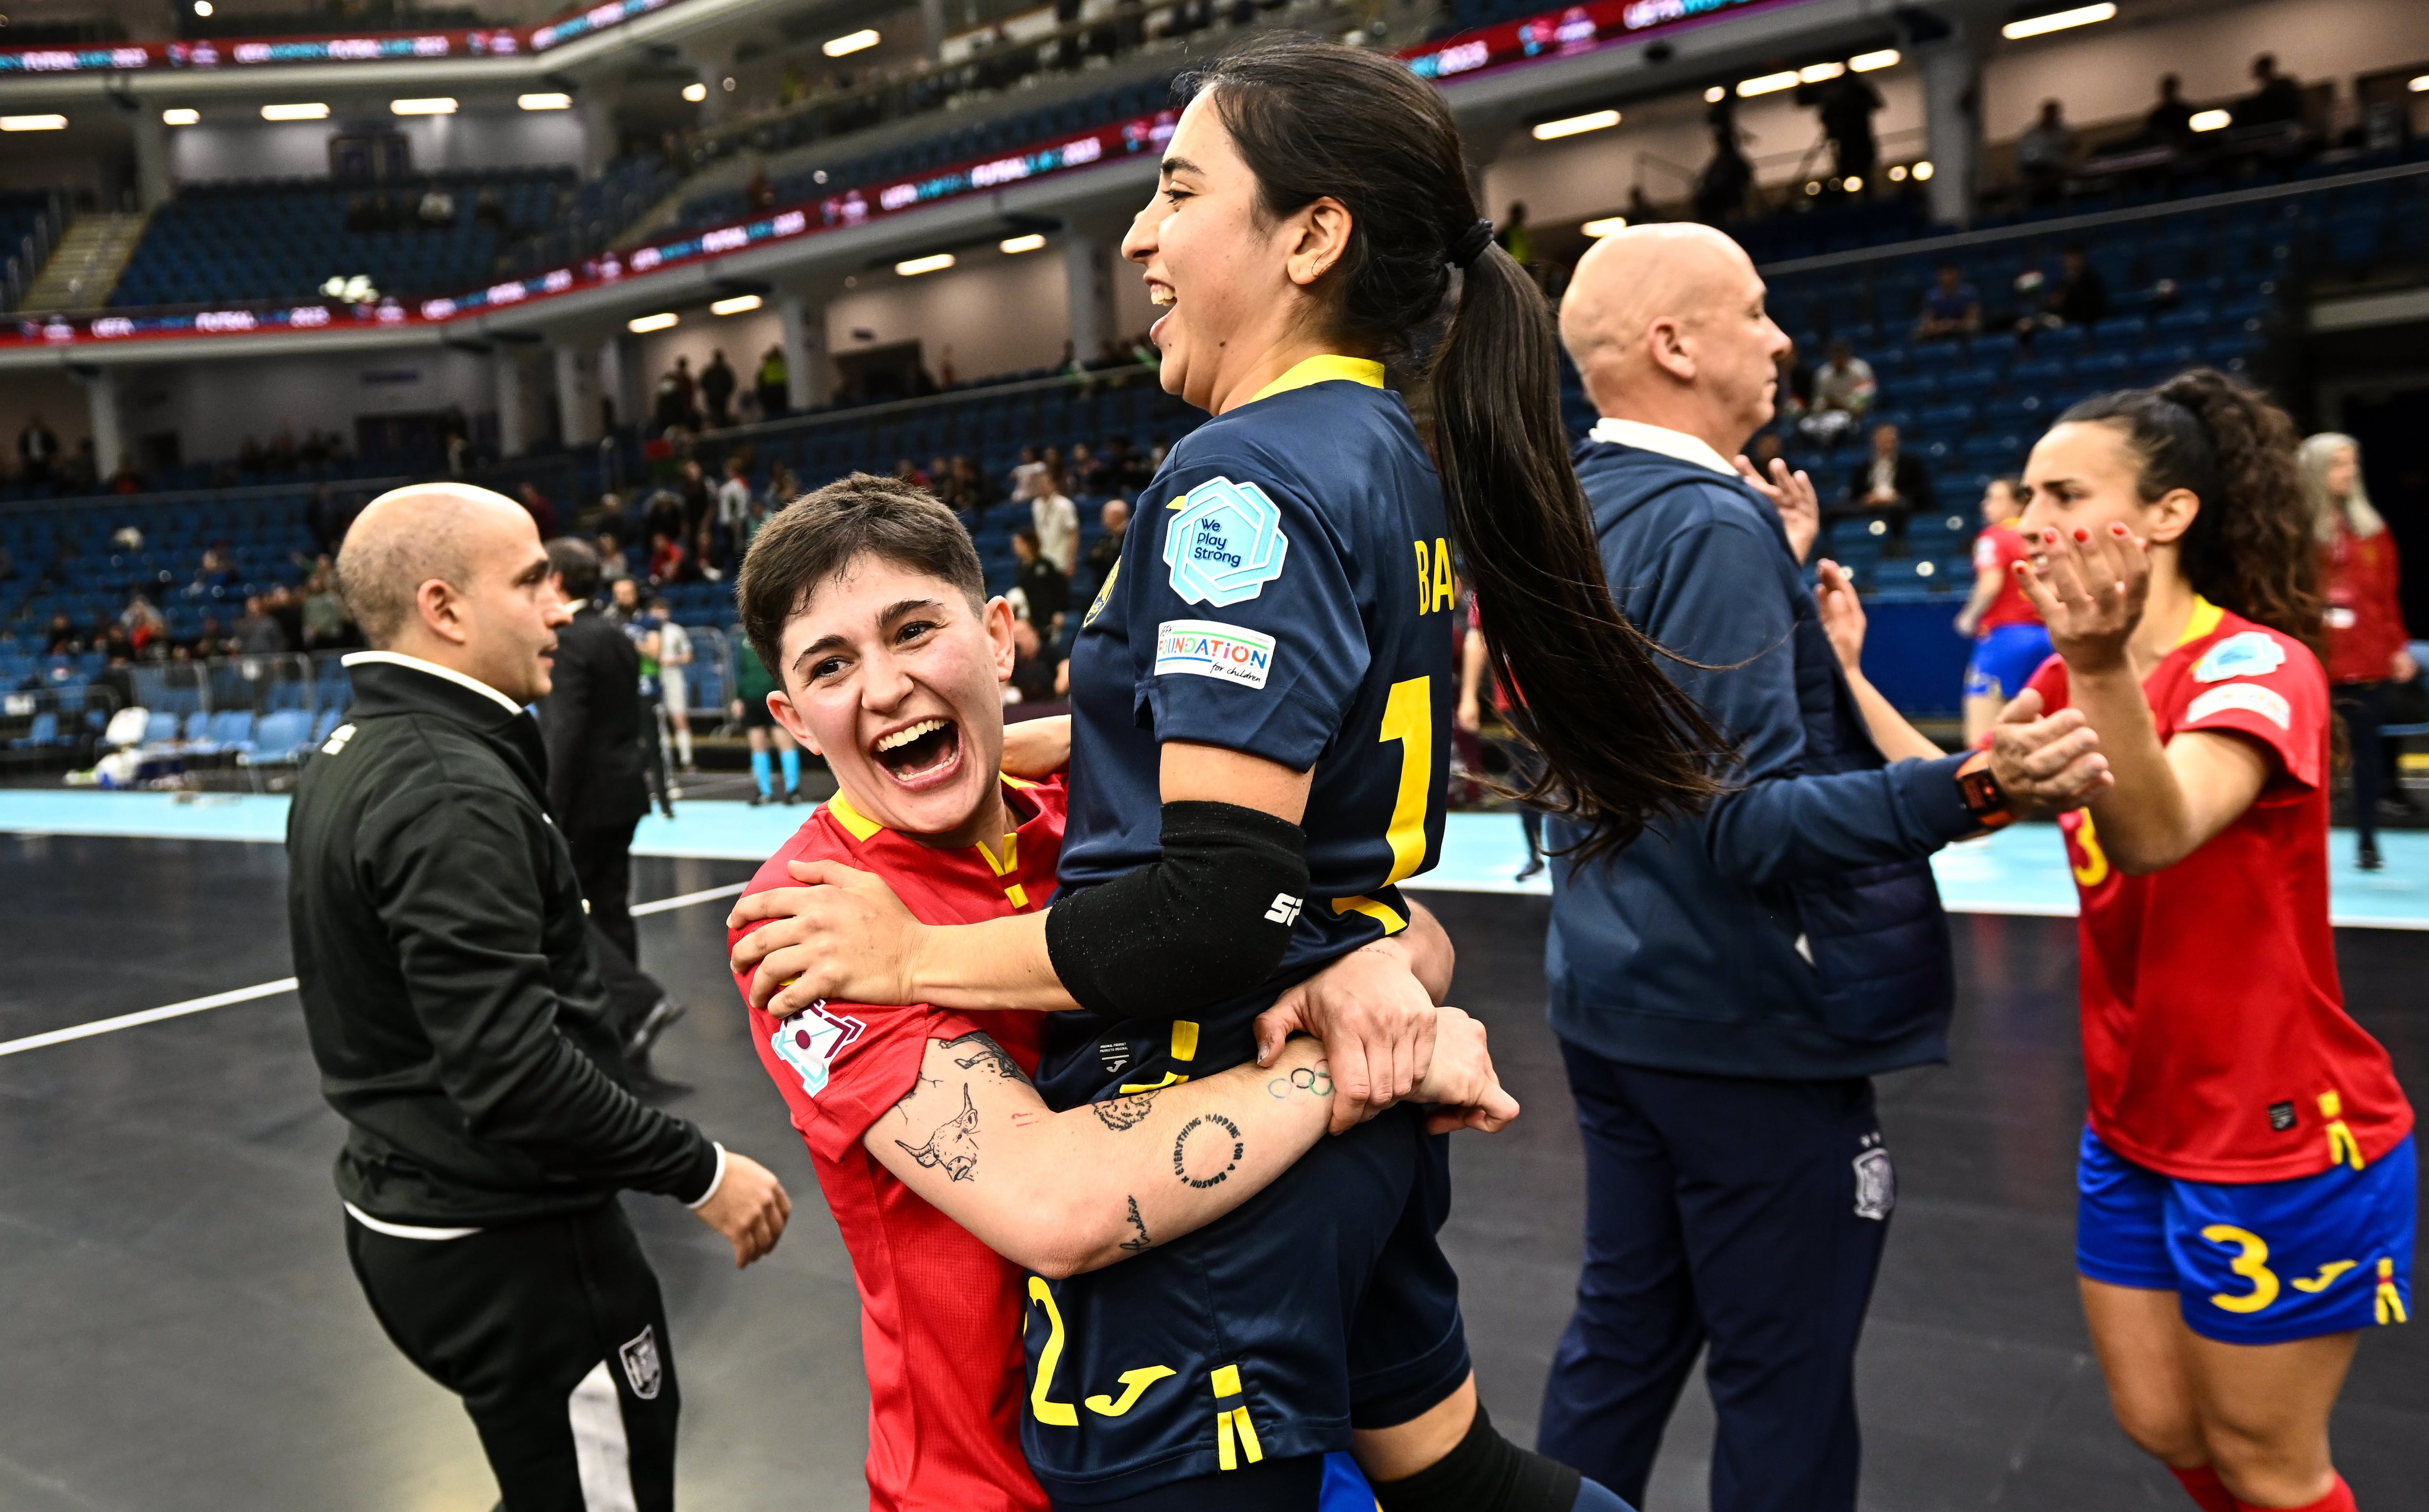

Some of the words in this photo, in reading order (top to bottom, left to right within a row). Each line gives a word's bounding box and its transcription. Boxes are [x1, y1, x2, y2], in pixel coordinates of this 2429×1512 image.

[1201, 518, 1220, 531] We
[1197, 532, 1227, 550] Play
[1194, 547, 1241, 567] Strong
[1414, 538, 1455, 616] BA
[1210, 662, 1225, 674] for
[1227, 667, 1261, 683] children
[1174, 1117, 1201, 1175] EVERYTHING
[1205, 1113, 1241, 1138] HAPPENS
[1233, 1143, 1244, 1160] FOR
[2200, 1223, 2280, 1313] 3
